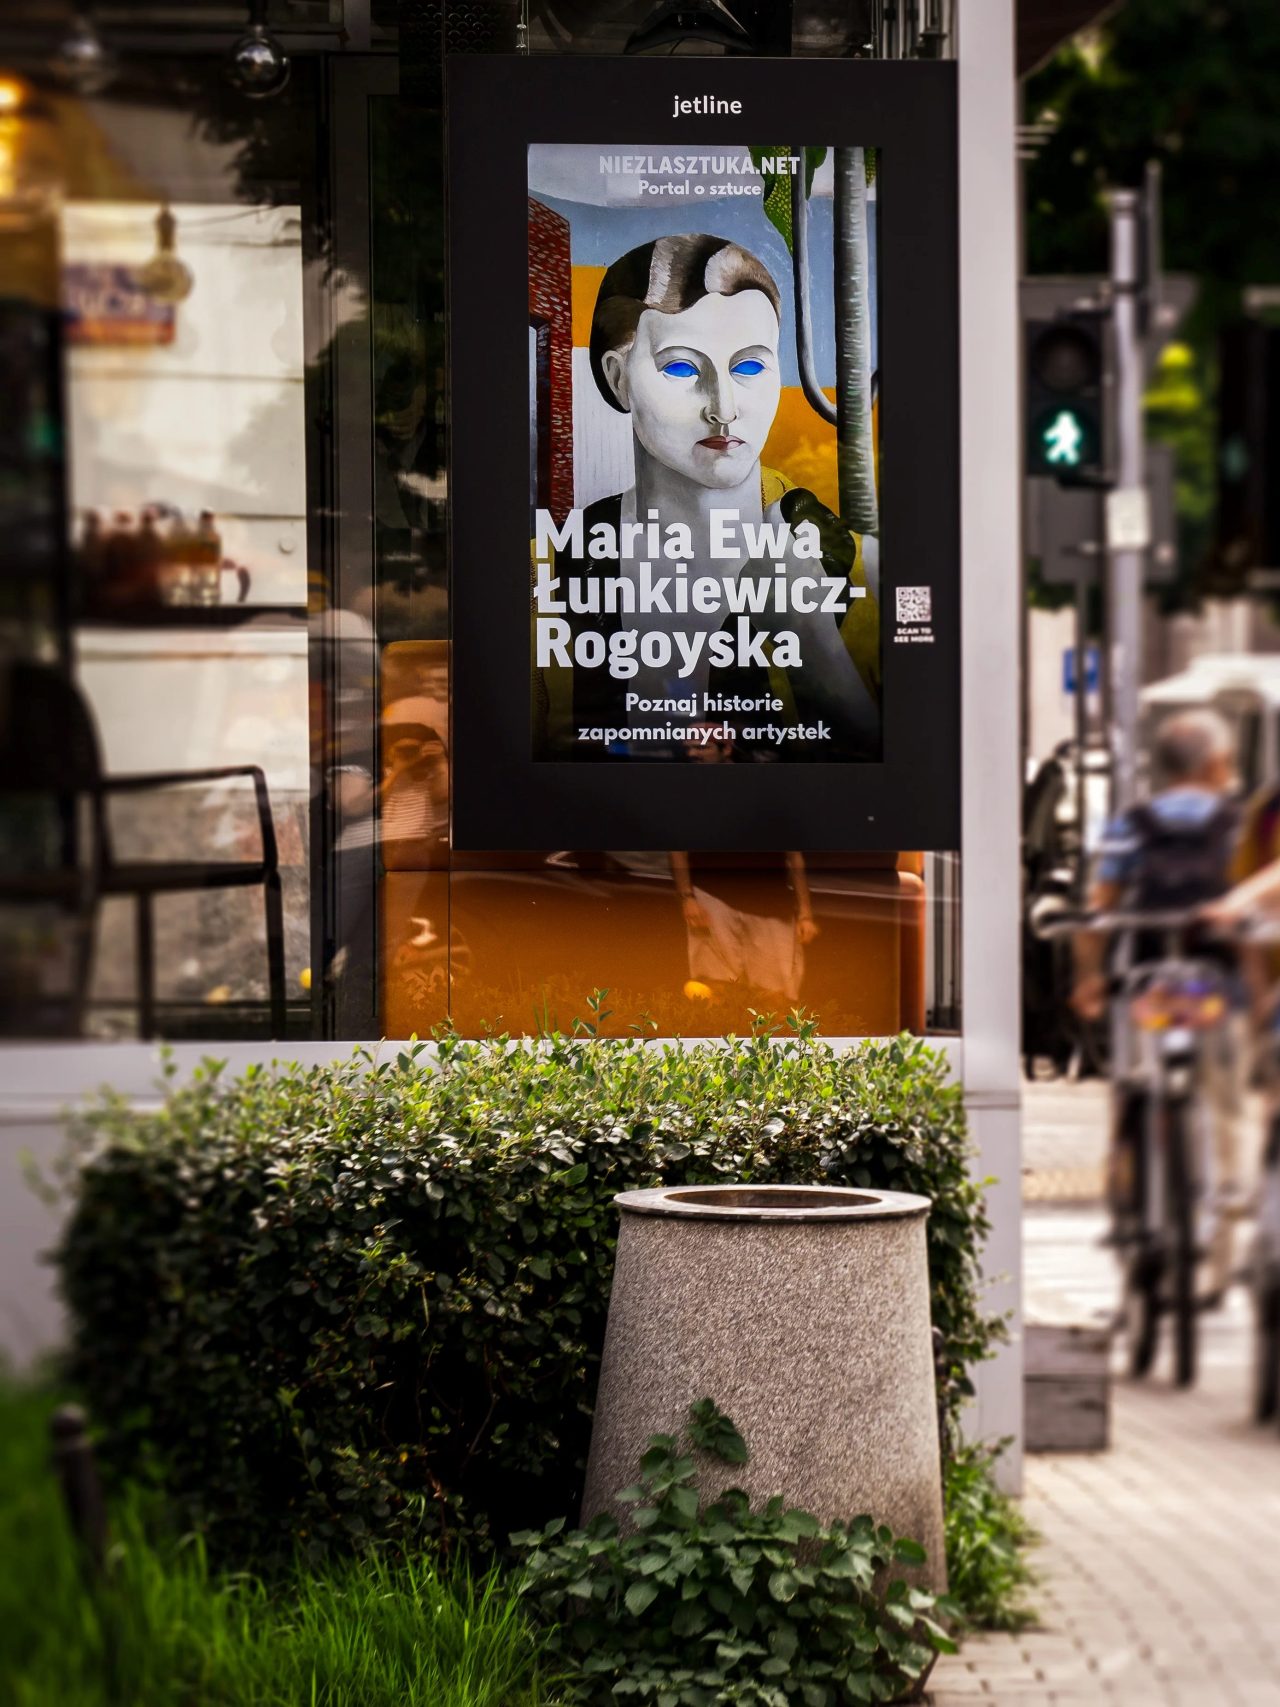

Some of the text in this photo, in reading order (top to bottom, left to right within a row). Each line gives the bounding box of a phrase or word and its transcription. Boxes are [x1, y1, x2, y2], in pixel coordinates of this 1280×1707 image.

[672, 95, 742, 118] jetline
[600, 155, 800, 175] NIEZLASZTUKA.NET
[639, 179, 762, 195] Portal o sztuce
[535, 508, 823, 559] Maria Ewa
[534, 562, 866, 614] Łunkiewicz-
[536, 616, 803, 679] Rogoyska
[625, 692, 784, 716] Poznaj historie
[578, 721, 832, 744] zapomnianych artystek
